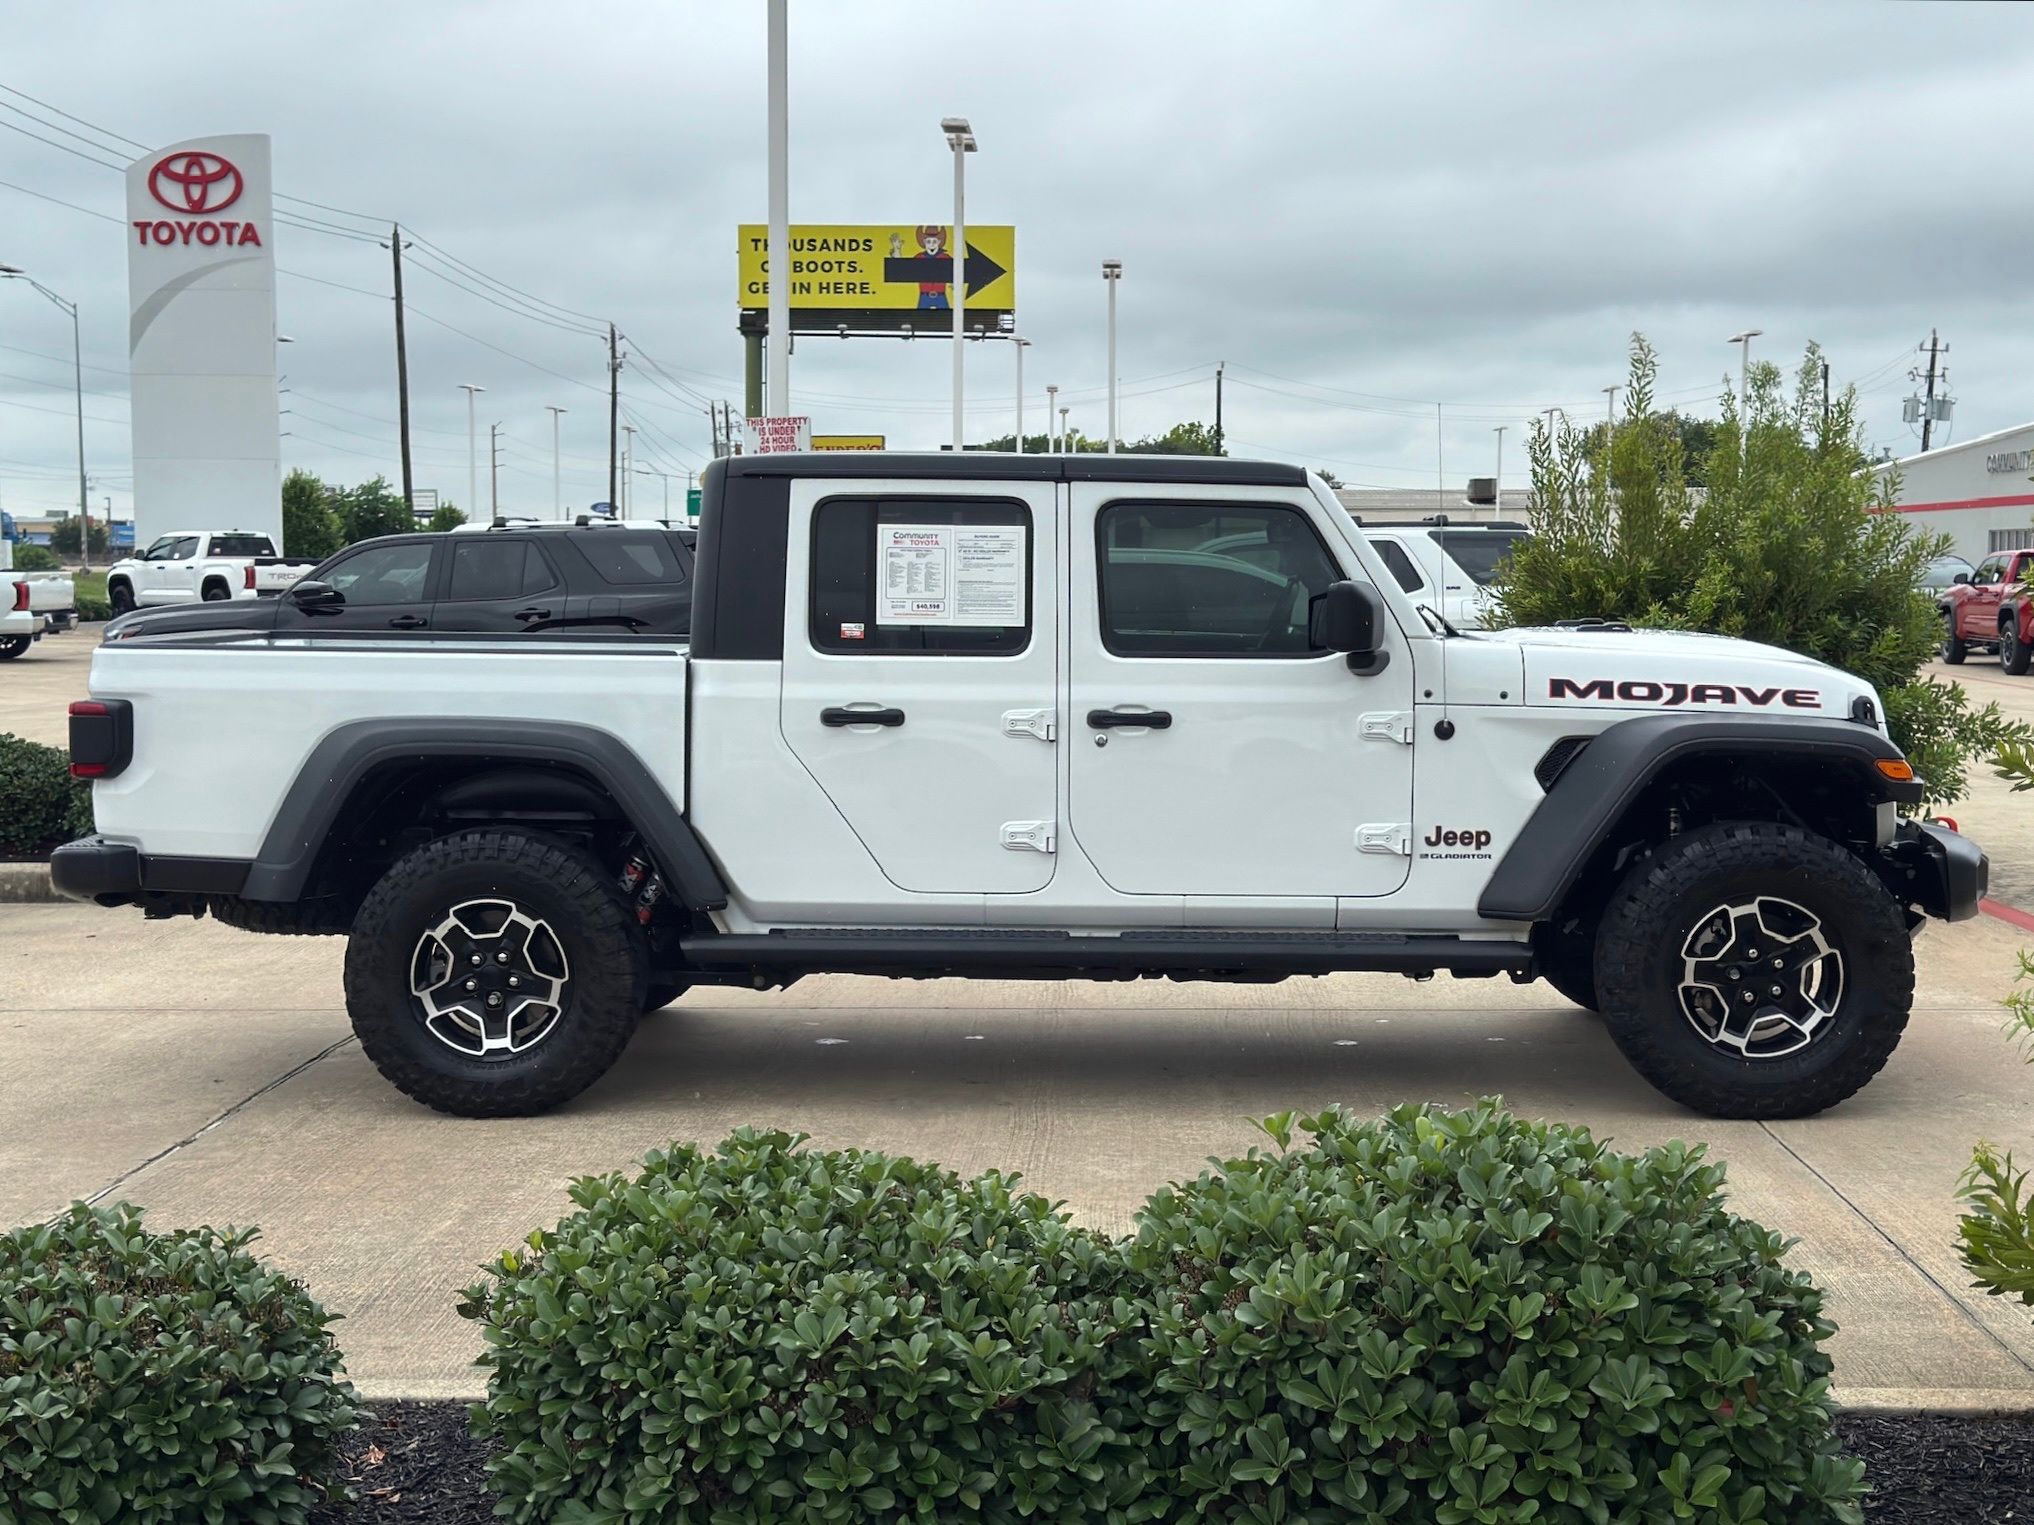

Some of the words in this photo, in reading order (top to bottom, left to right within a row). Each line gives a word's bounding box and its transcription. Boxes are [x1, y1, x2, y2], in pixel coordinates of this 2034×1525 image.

[133, 220, 262, 247] TOYOTA
[751, 238, 873, 252] TUSANDS
[793, 260, 864, 273] BOOTS.
[792, 281, 811, 294] IN
[818, 281, 876, 294] HERE.
[746, 418, 765, 427] THIS
[766, 416, 809, 426] PROPERTY
[758, 427, 766, 436] IS
[768, 426, 796, 436] UNDER
[760, 437, 770, 445] 24
[772, 436, 795, 444] HOUR
[759, 445, 771, 454] HD
[772, 444, 797, 452] VIDEO
[1549, 678, 1822, 709] MOJAVE
[1424, 825, 1491, 851] Jeep
